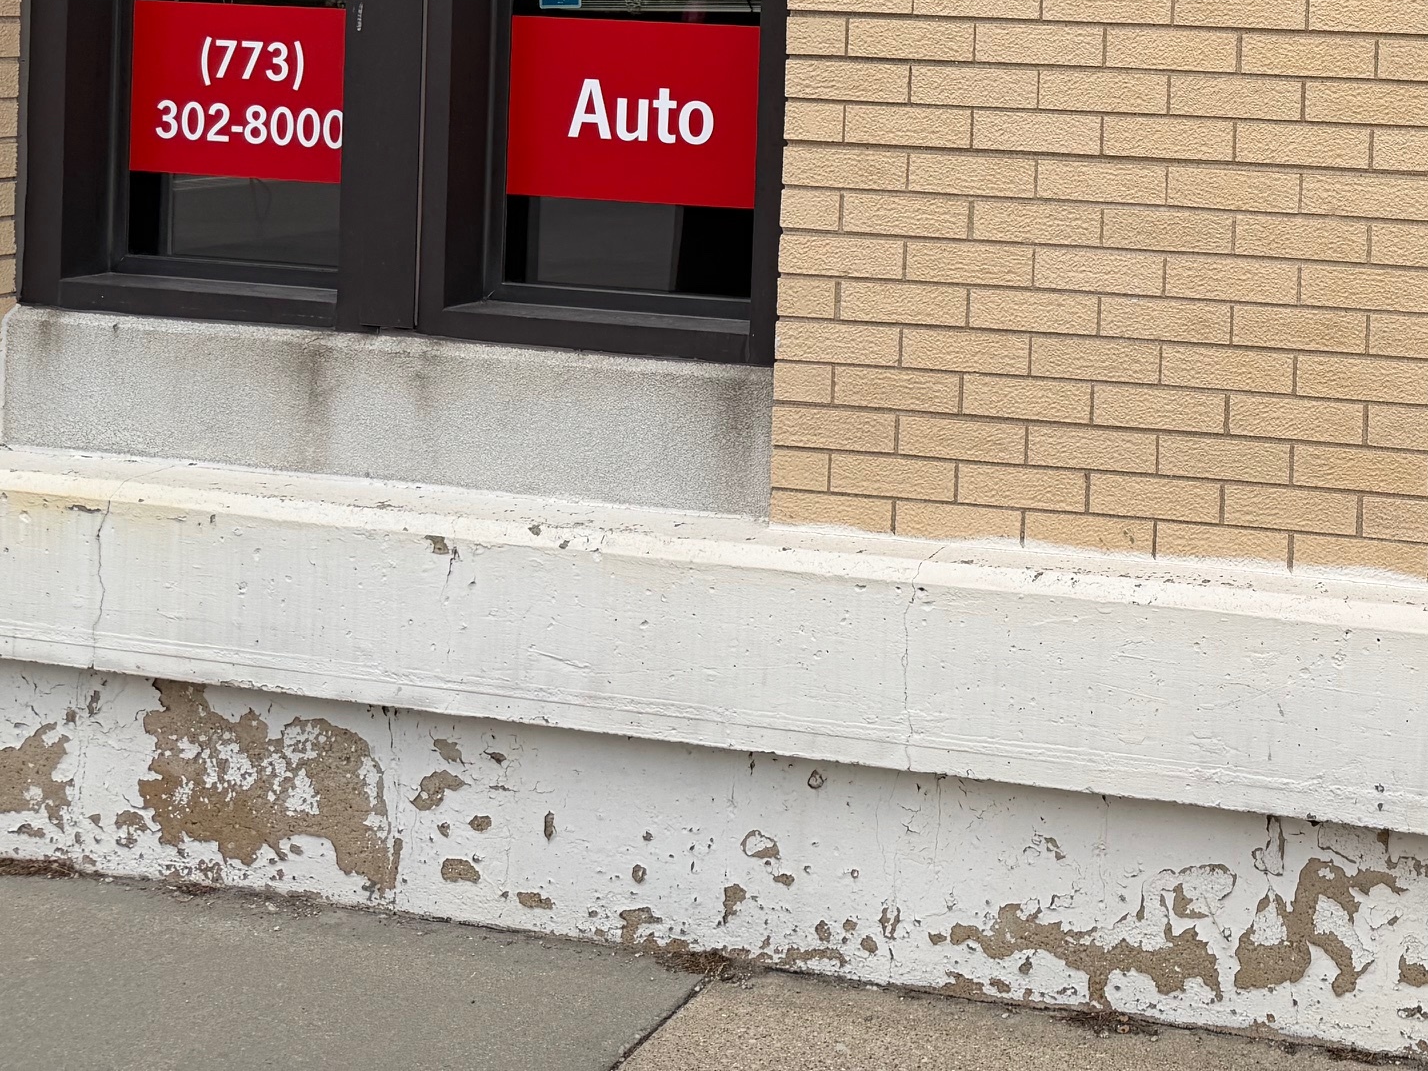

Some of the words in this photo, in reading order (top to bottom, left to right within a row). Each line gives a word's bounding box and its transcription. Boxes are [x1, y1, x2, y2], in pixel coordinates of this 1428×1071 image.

[201, 36, 305, 91] (773)
[155, 100, 343, 150] 302-8000
[567, 78, 714, 145] Auto
